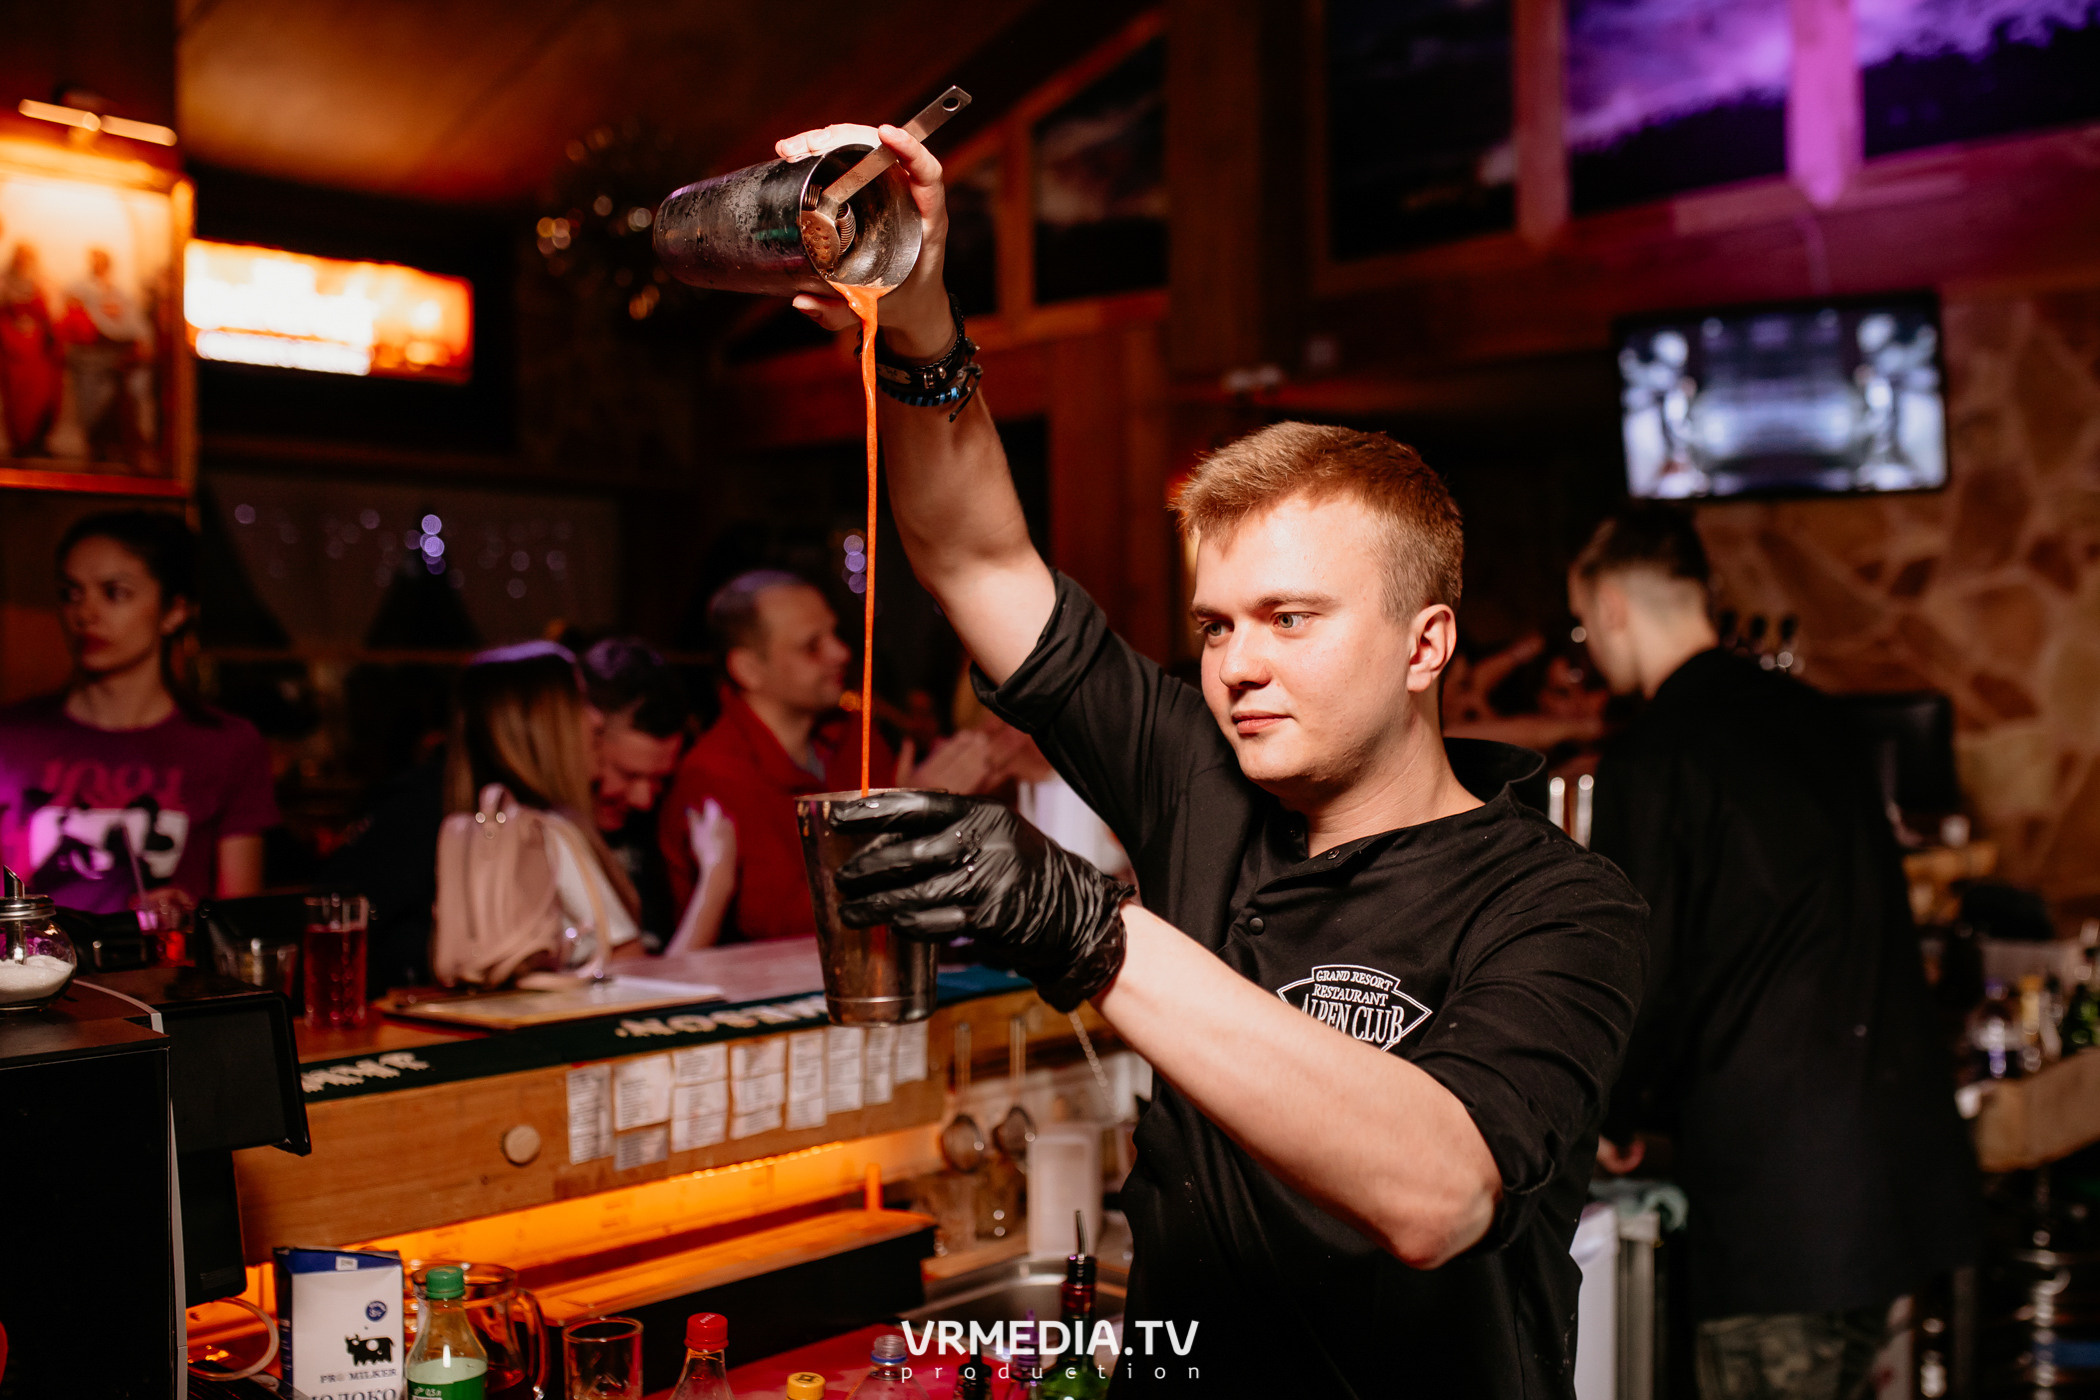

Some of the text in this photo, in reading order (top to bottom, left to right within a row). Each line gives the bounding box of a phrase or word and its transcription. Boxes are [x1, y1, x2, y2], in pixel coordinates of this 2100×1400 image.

[1315, 970, 1394, 992] GRAND RESORT
[1311, 983, 1389, 1007] RESTAURANT
[1351, 1005, 1405, 1046] CLUB
